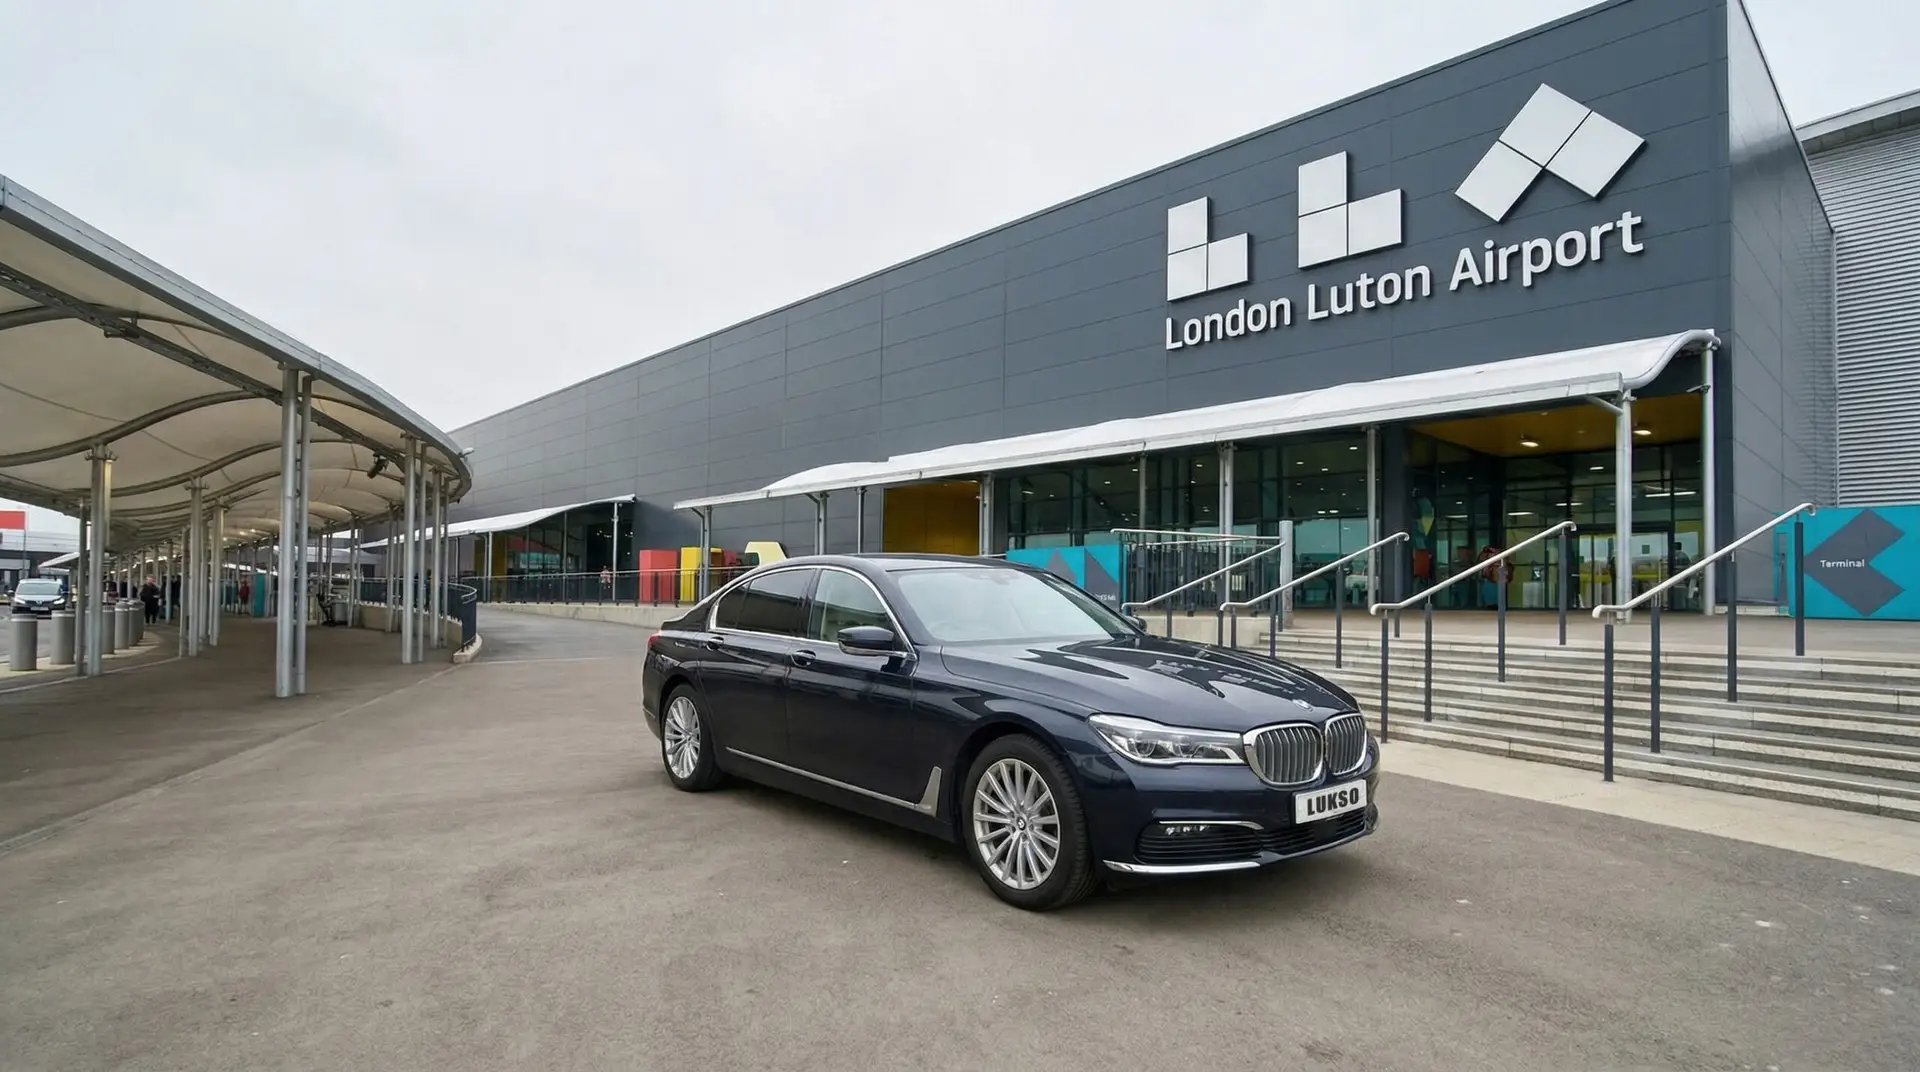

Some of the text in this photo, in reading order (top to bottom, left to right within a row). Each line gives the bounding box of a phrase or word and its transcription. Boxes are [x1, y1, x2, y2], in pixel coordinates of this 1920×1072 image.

[1166, 210, 1644, 350] London Luton Airport
[1820, 559, 1865, 568] Terminal
[1307, 787, 1359, 816] LUKSO
